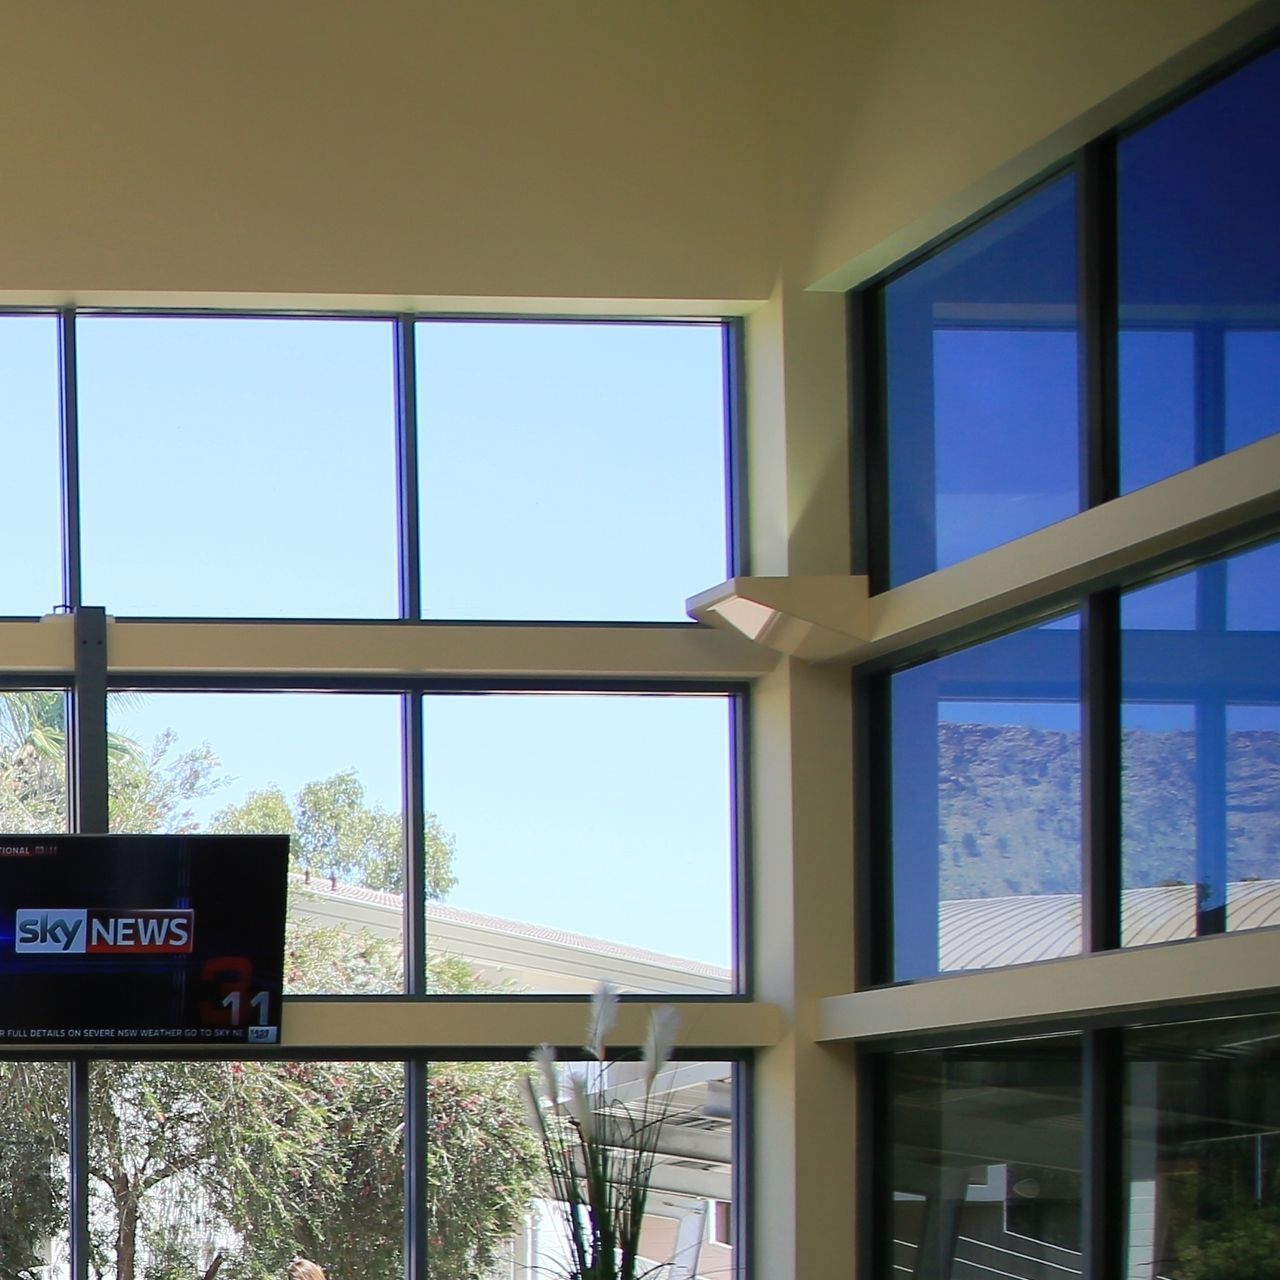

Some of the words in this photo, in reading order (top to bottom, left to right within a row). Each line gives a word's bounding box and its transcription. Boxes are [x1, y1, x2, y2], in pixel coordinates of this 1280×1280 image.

[19, 911, 83, 951] sky
[91, 918, 188, 946] NEWS
[7, 1029, 27, 1037] FULL
[30, 1029, 65, 1037] DETAILS
[68, 1029, 81, 1037] ON
[83, 1029, 115, 1037] SEVERE
[117, 1029, 138, 1037] NSW
[140, 1029, 182, 1037] WEATHER
[184, 1029, 197, 1037] GO
[200, 1029, 211, 1037] TO
[214, 1029, 230, 1037] SKY
